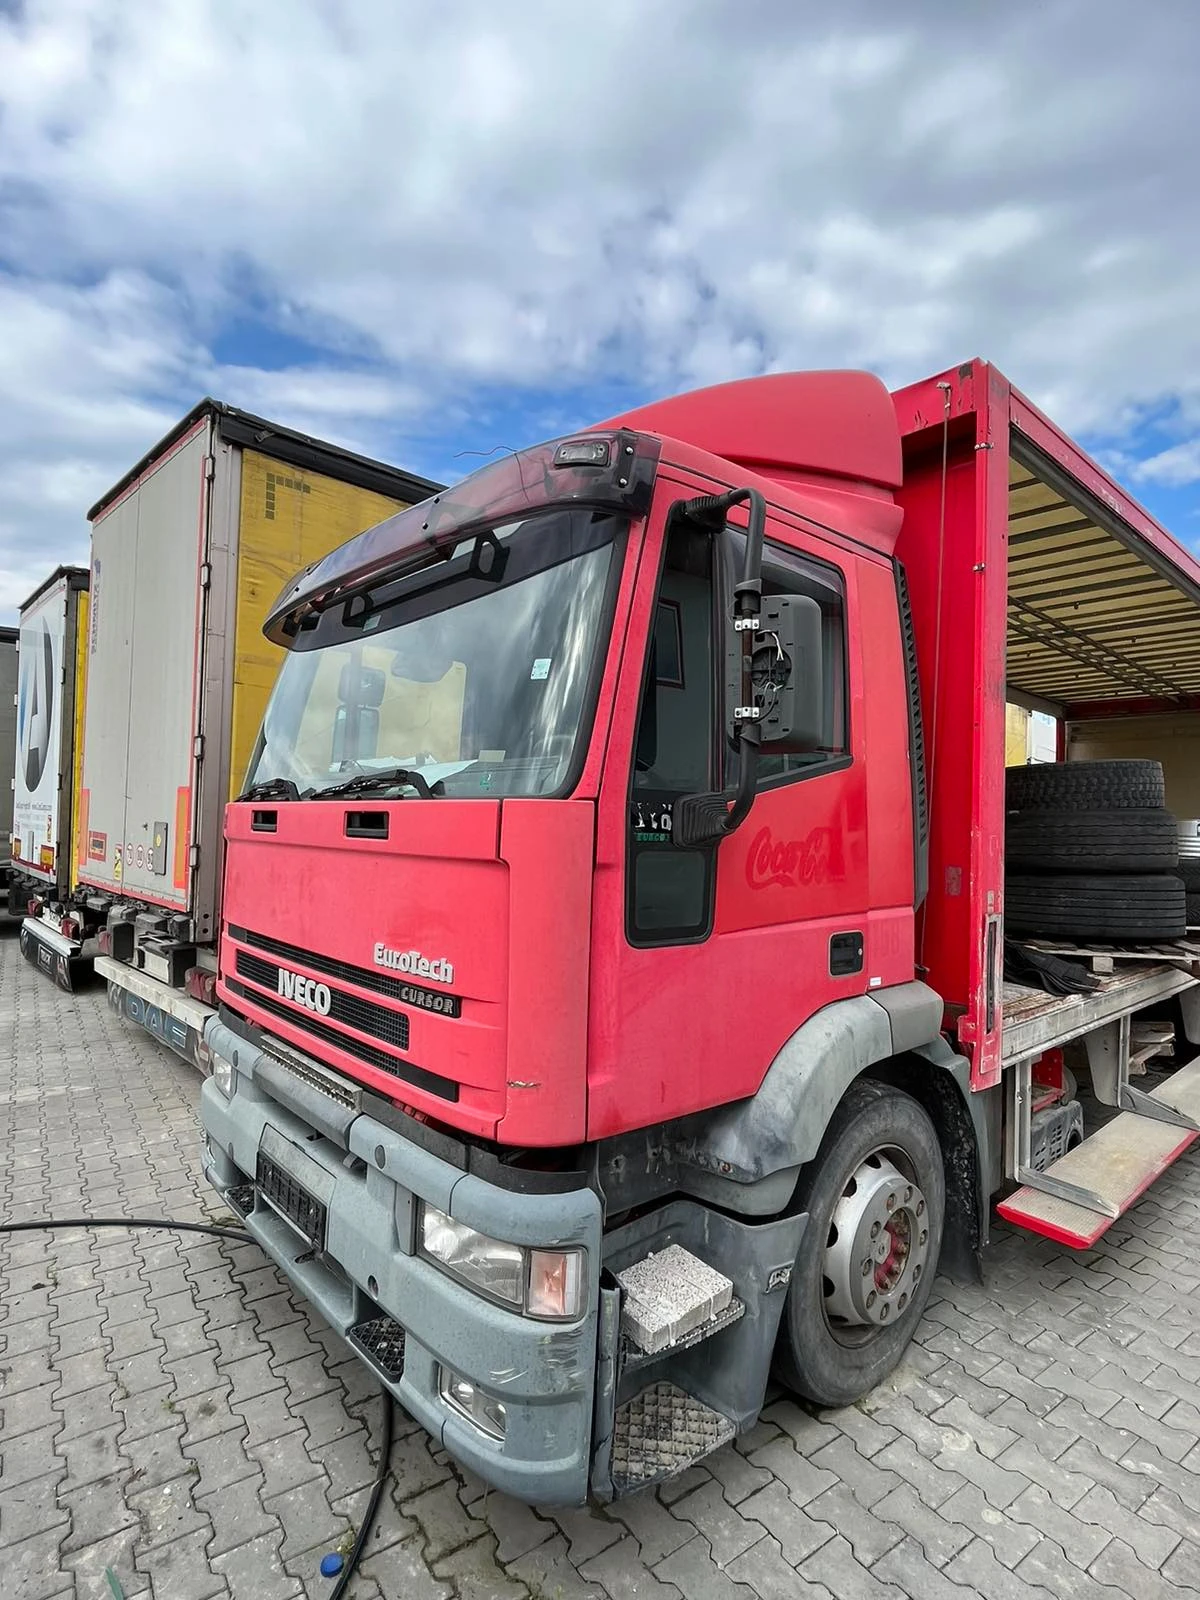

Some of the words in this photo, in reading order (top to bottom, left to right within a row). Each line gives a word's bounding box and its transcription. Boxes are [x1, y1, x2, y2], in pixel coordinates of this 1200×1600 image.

[745, 826, 845, 890] Coca-Co
[374, 942, 453, 984] EuroTech
[278, 968, 331, 1016] IVECO
[401, 987, 453, 1014] CURSOR
[126, 990, 188, 1049] DAF
